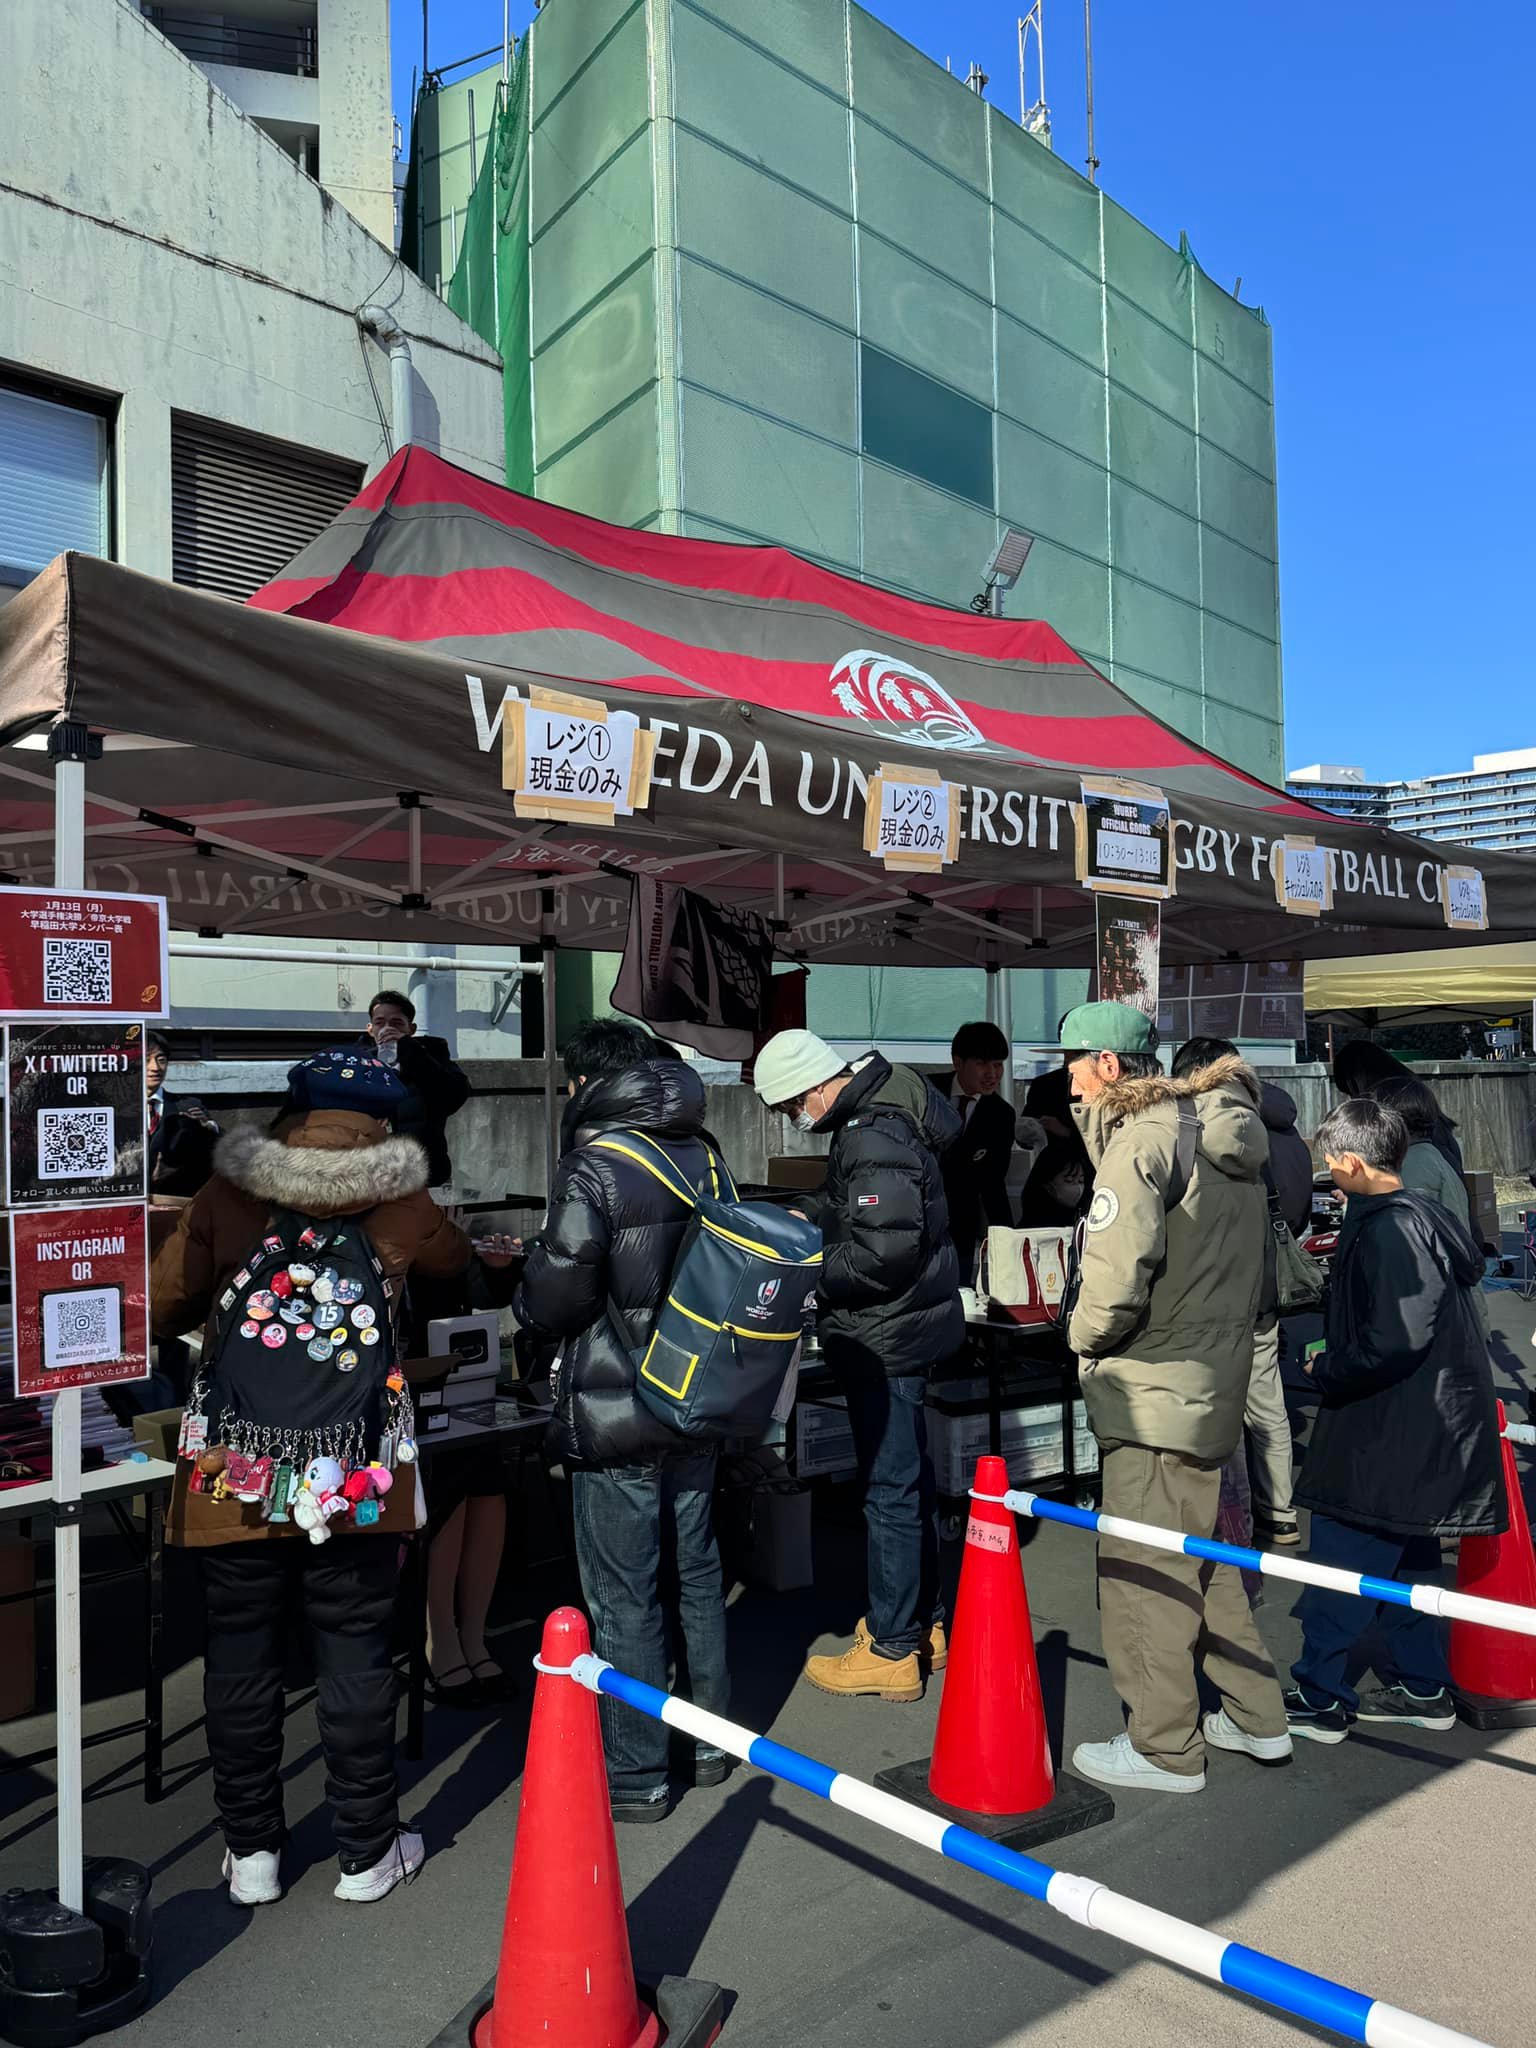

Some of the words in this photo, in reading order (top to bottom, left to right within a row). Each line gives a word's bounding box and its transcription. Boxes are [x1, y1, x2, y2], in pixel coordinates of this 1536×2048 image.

[546, 721, 611, 761] レジ①
[465, 674, 773, 806] WEDA
[1251, 835, 1411, 901] FTBALL
[530, 756, 623, 798] 現金のみ
[893, 788, 936, 820] レジ②
[1113, 804, 1138, 818] WURFC
[880, 817, 945, 850] 現金のみ
[1101, 816, 1129, 833] OFFICIAL
[1129, 821, 1152, 836] GOODS
[66, 1076, 88, 1096] QR
[37, 1236, 125, 1262] INSTAGRAM
[71, 1261, 92, 1281] QR
[320, 1305, 338, 1322] 15
